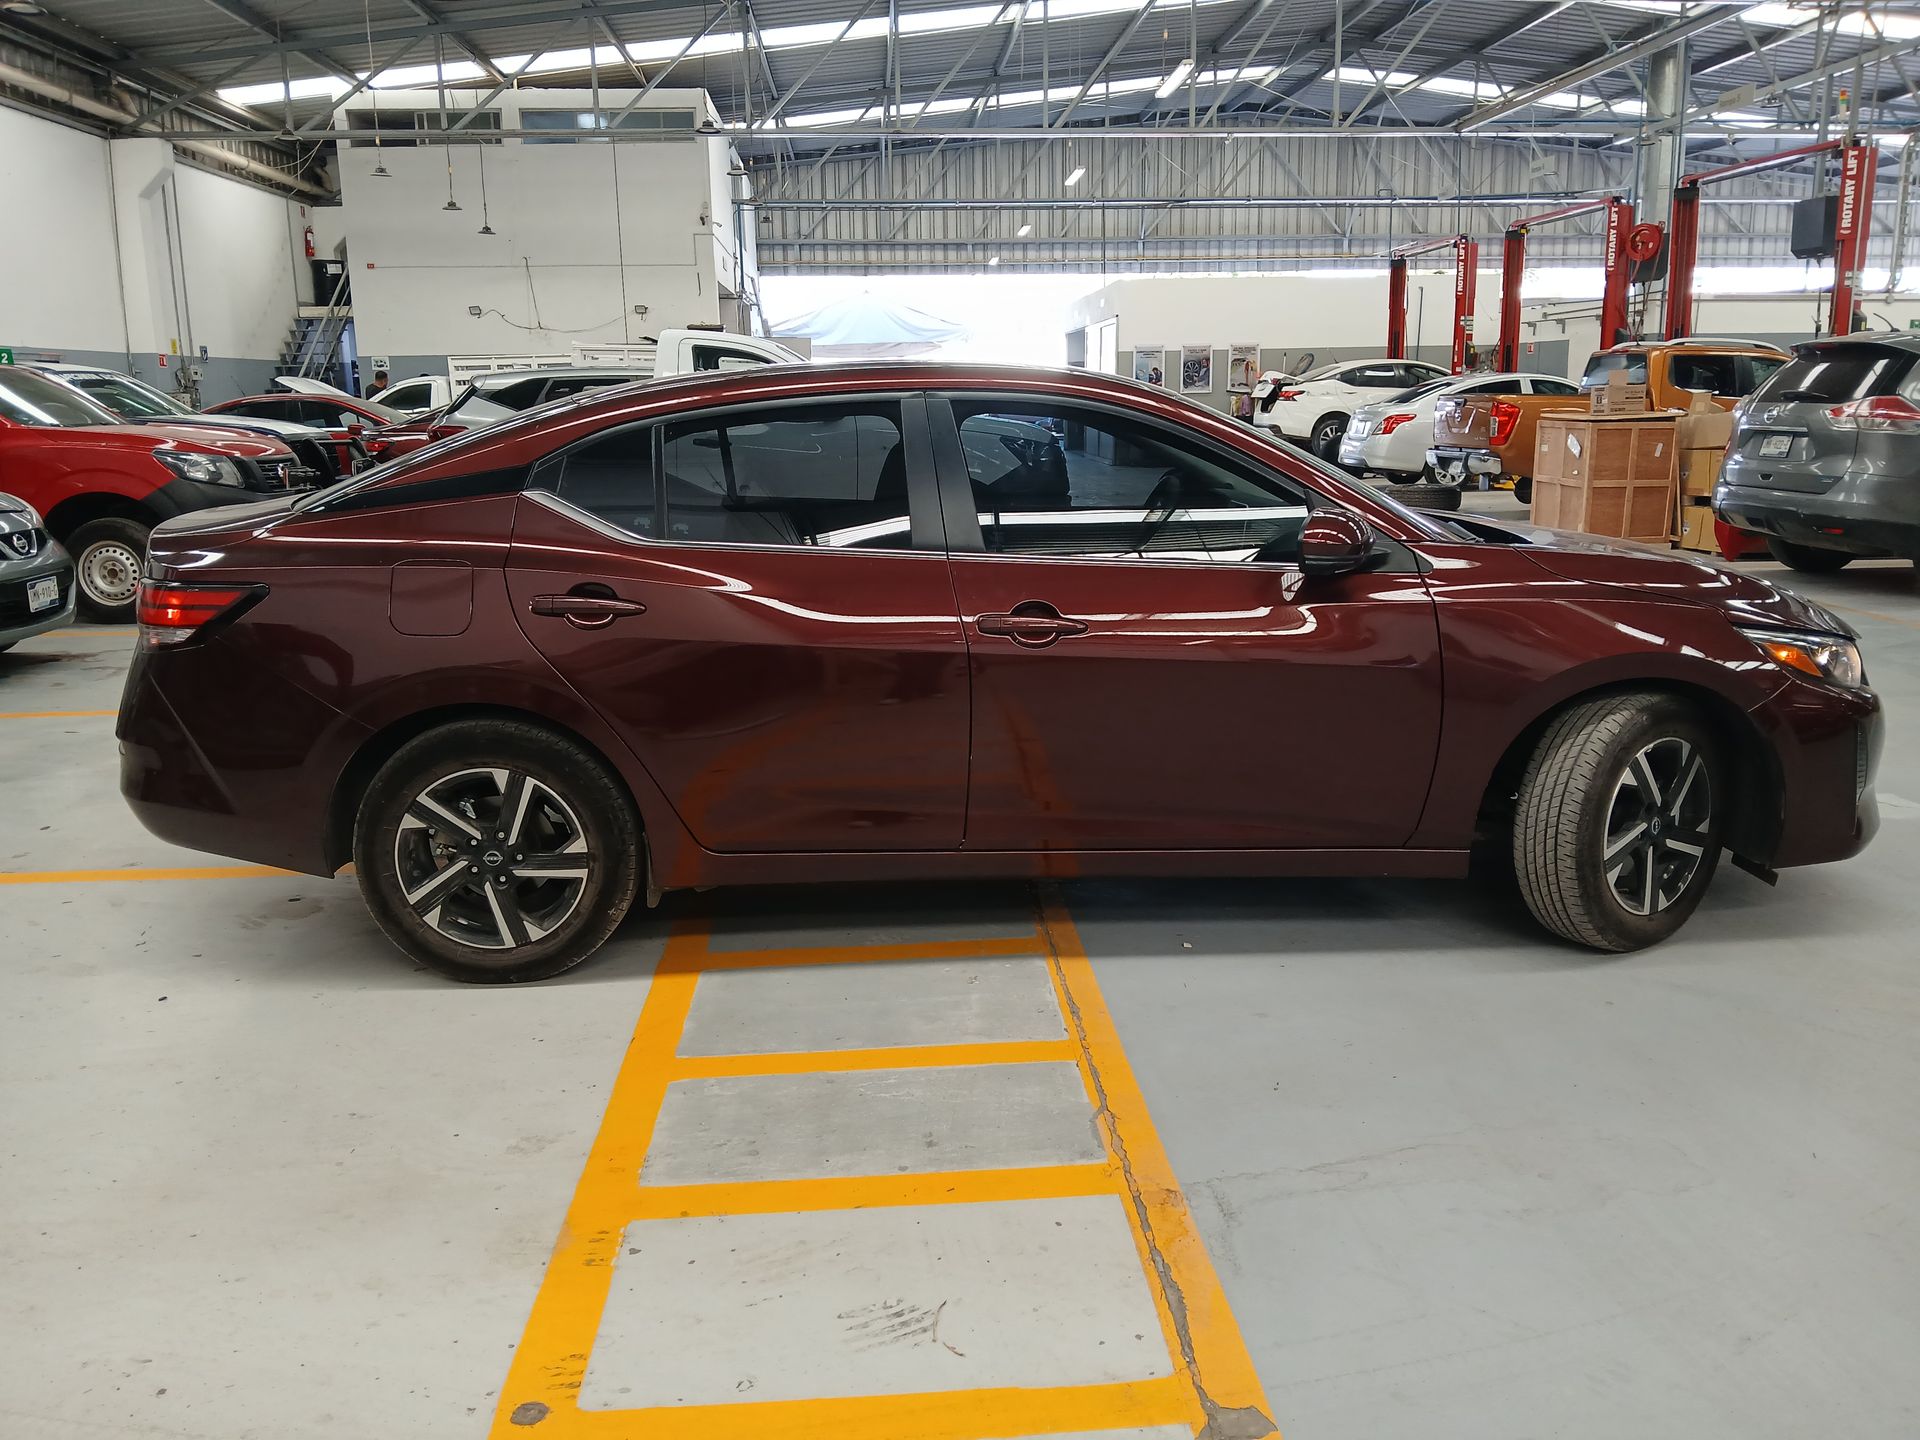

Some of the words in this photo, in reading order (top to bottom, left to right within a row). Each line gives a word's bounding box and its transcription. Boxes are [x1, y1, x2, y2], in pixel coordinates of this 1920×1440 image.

[1846, 149, 1859, 176] LIFT
[1610, 206, 1619, 227] LIFT
[1841, 179, 1856, 228] ROTARY
[1607, 228, 1617, 266] ROTARY
[1457, 261, 1465, 292] ROTARY
[1, 353, 9, 364] 2
